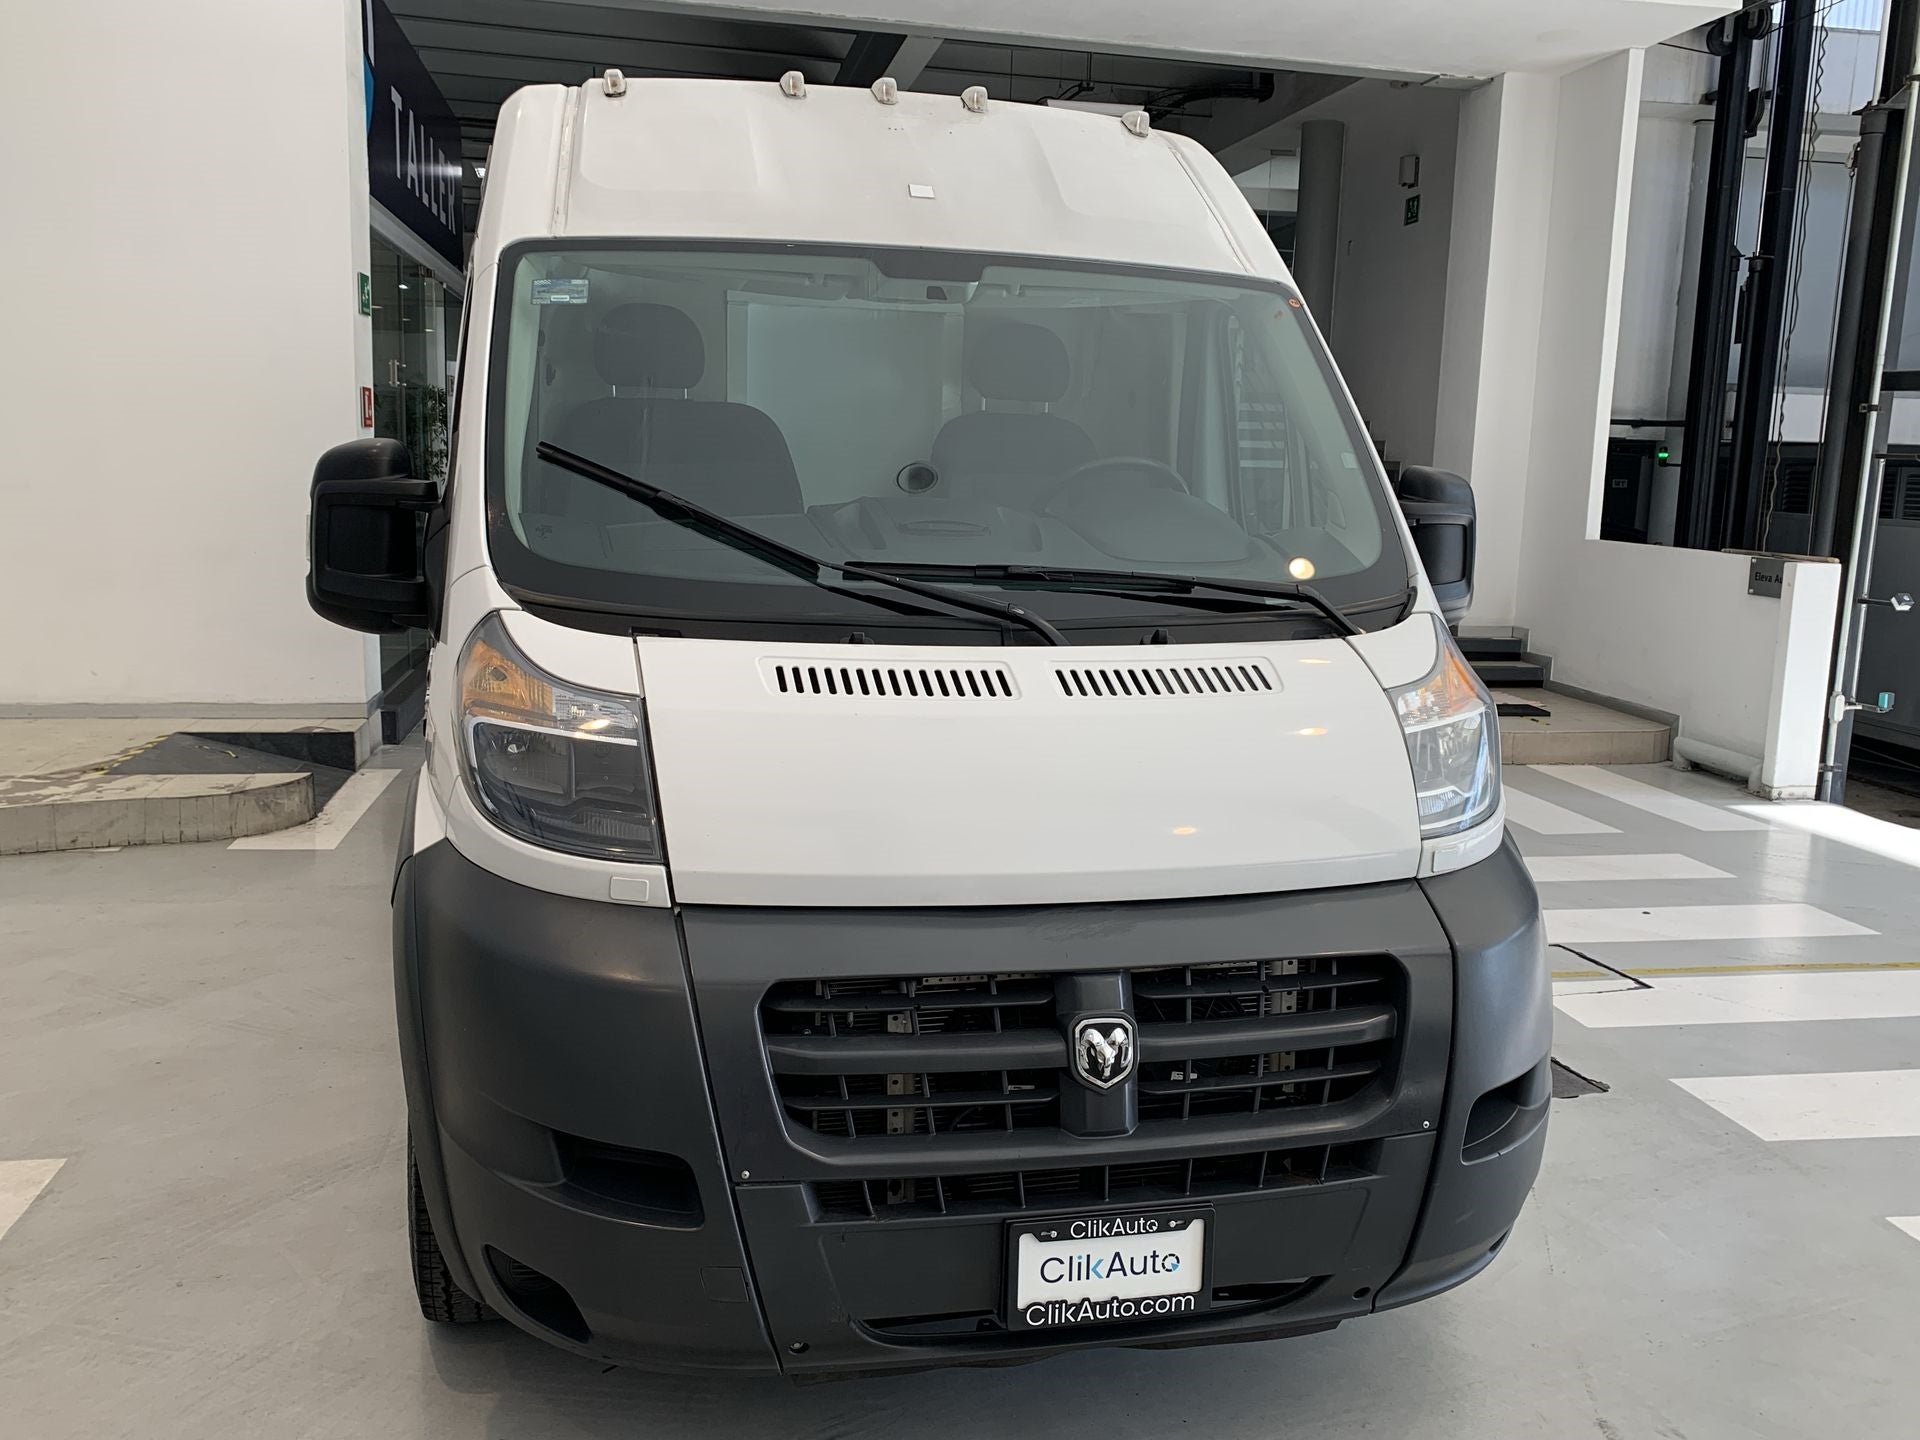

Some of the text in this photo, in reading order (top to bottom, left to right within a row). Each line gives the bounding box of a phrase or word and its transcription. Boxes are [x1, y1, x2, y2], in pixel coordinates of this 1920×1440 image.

[390, 85, 456, 235] TALLER
[1070, 1218, 1159, 1238] ClikAuto
[1040, 1250, 1181, 1283] ClikAuto
[1026, 1294, 1195, 1326] ClikAuto.com
